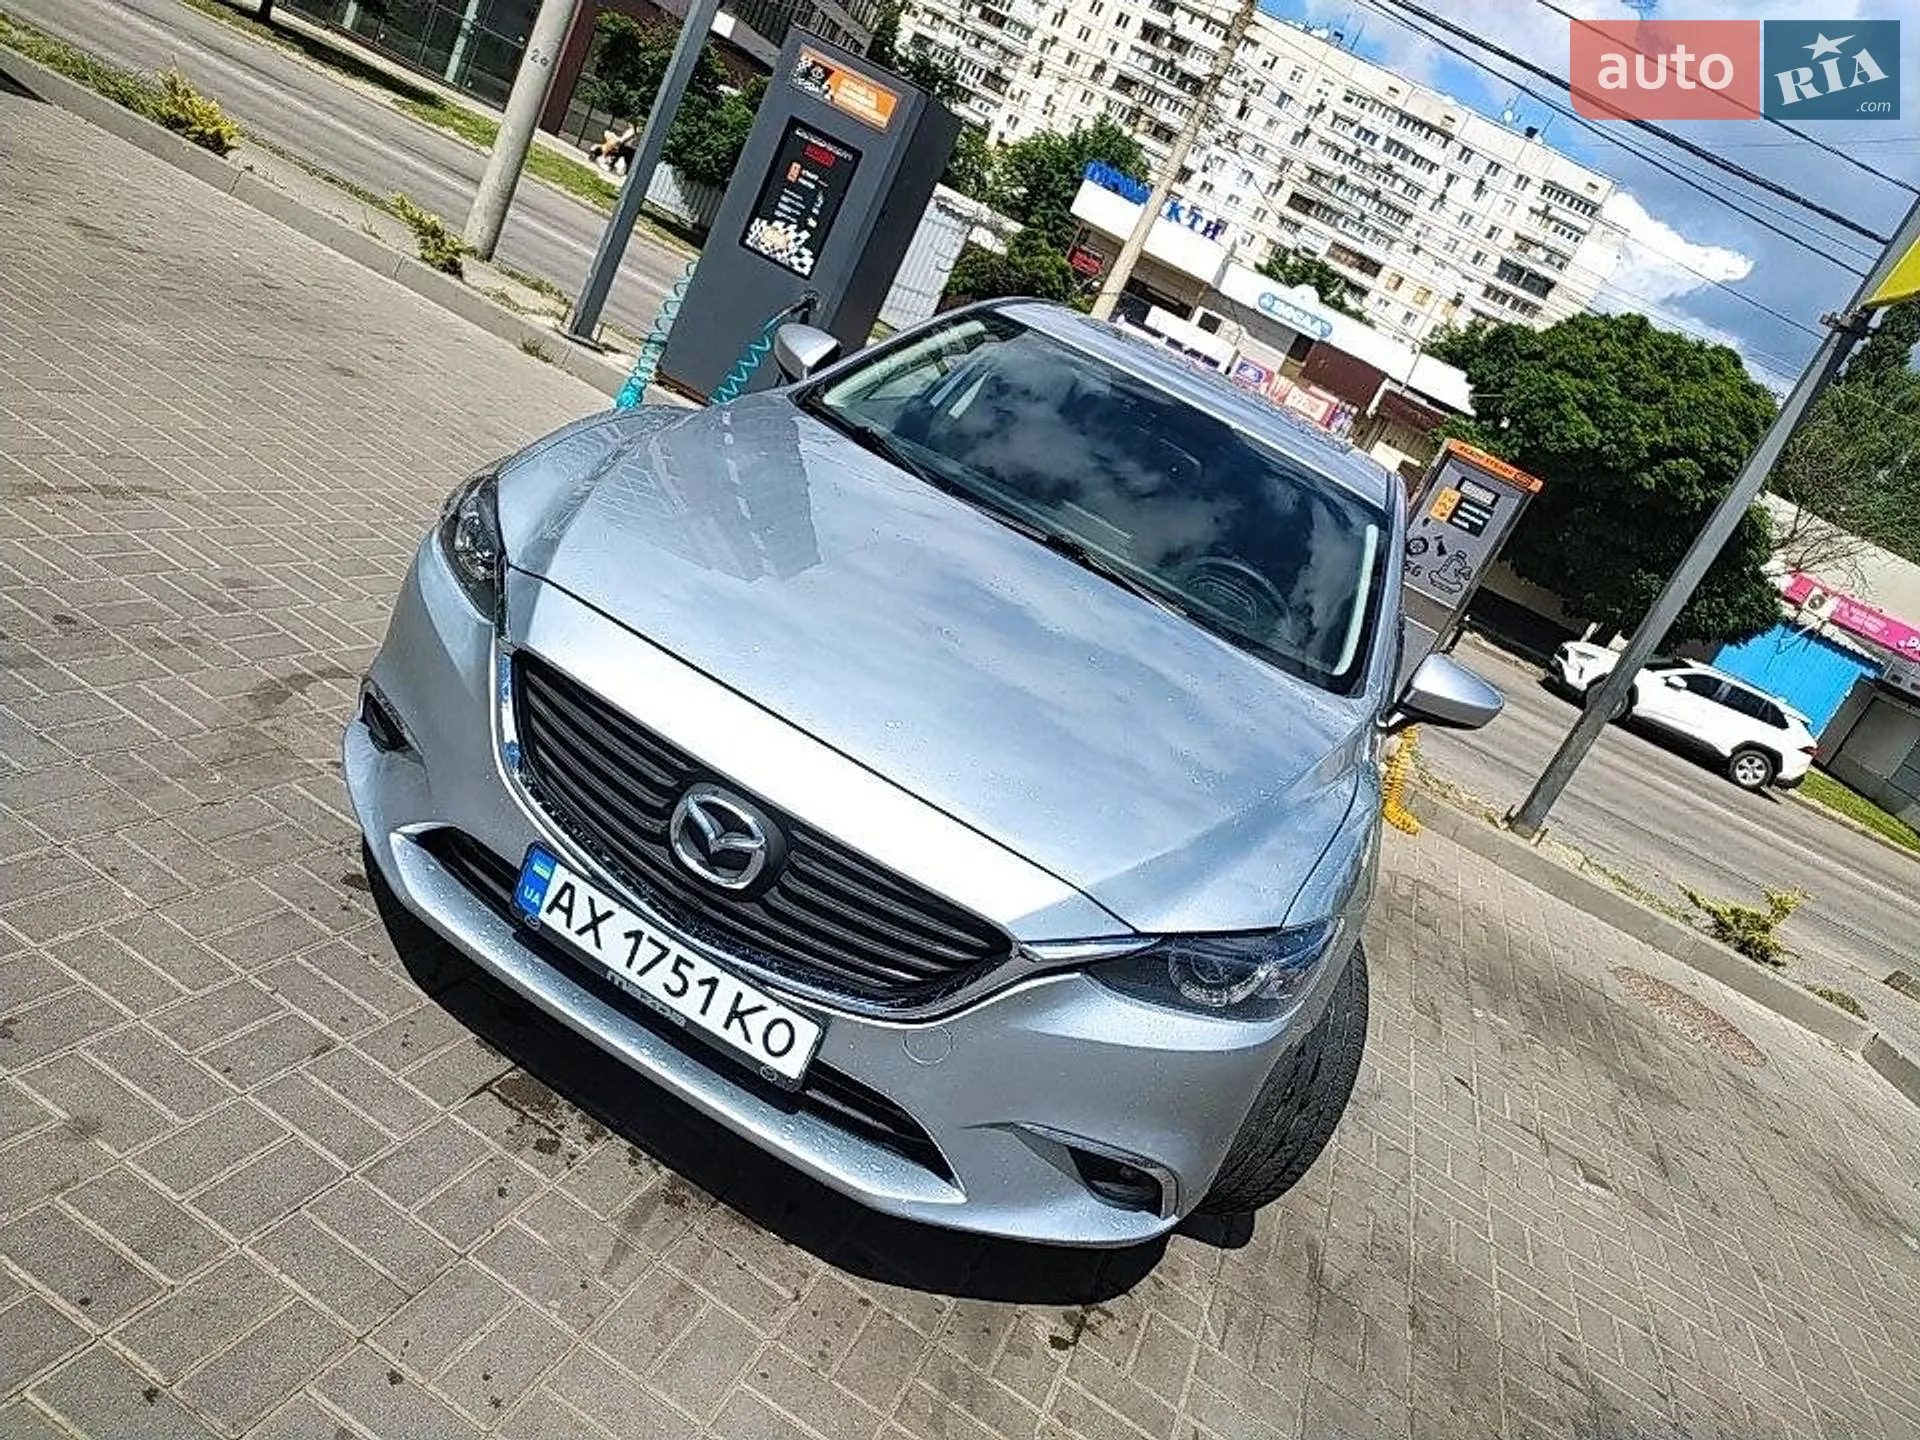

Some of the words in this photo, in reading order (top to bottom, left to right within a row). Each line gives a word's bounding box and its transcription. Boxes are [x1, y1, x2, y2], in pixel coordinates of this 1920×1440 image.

[546, 882, 615, 950] AX
[623, 929, 719, 1016] 1751
[723, 991, 796, 1058] KO
